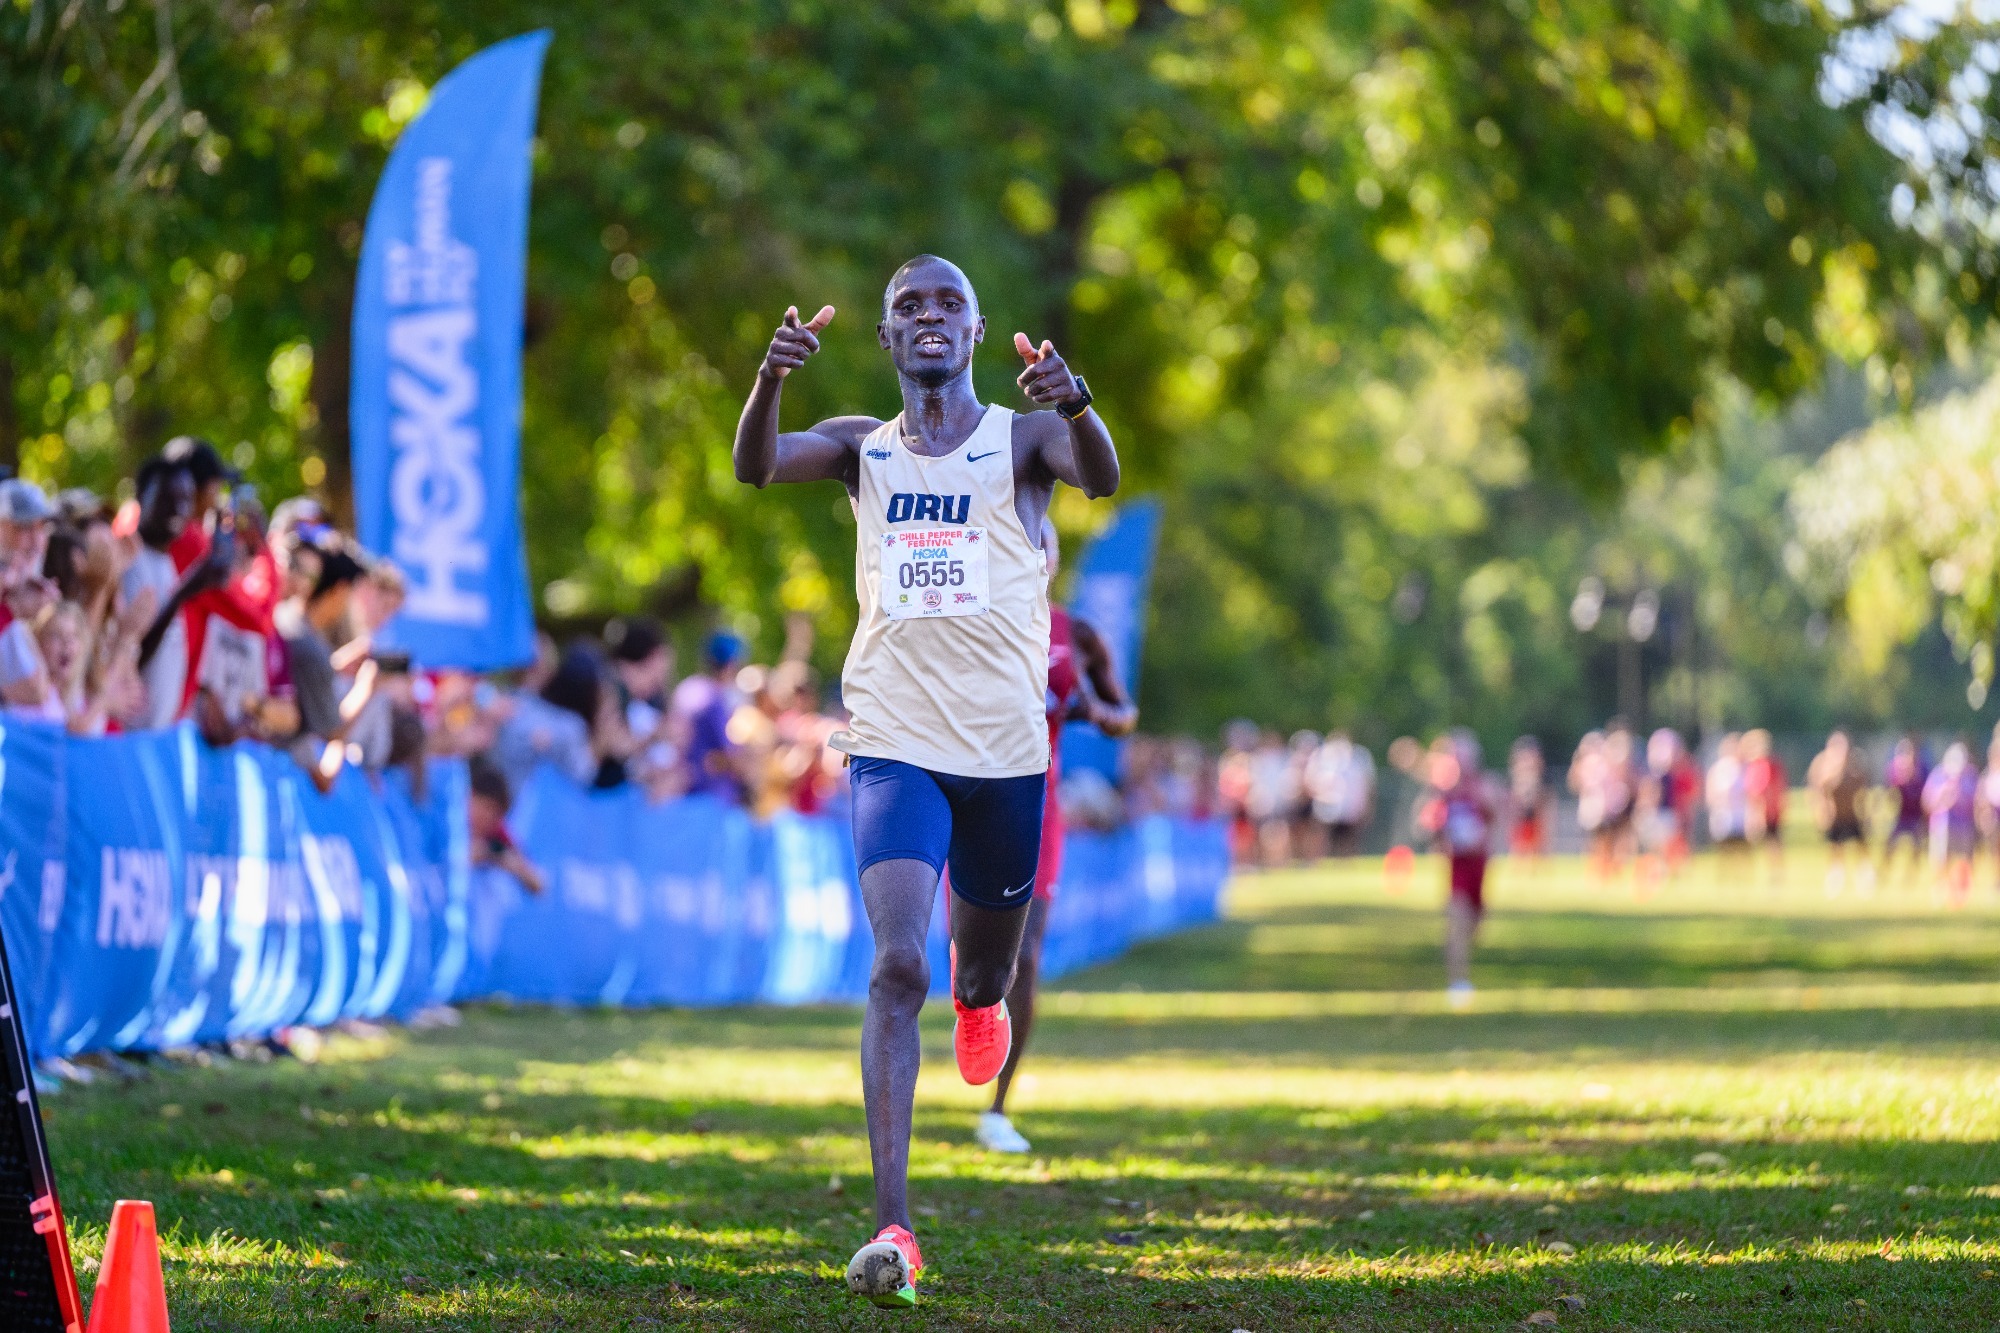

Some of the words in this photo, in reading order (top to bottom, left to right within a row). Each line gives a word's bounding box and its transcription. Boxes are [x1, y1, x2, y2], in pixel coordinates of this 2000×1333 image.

[386, 306, 490, 628] HOKA
[887, 493, 971, 524] ORU
[899, 532, 925, 542] CHILE
[928, 530, 963, 540] PEPPER
[907, 539, 954, 548] FESTIVAL
[912, 548, 949, 560] HOKA
[899, 560, 965, 589] 0555
